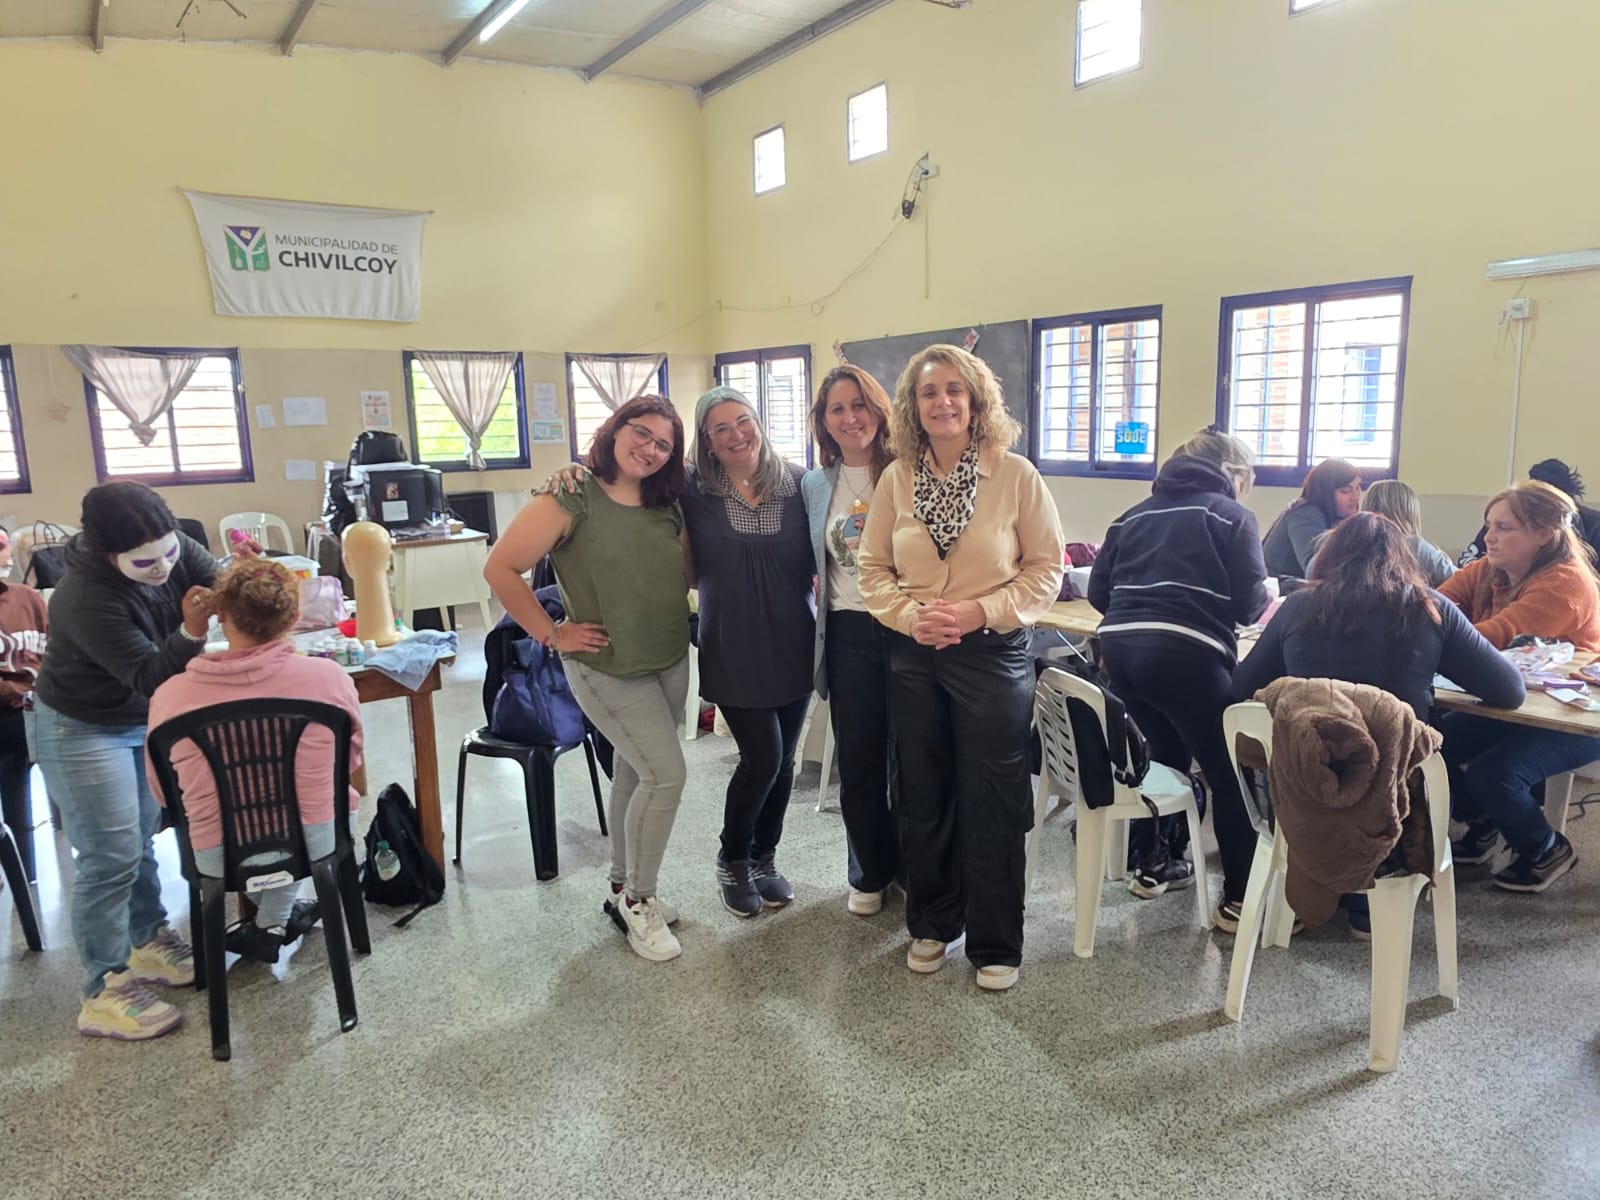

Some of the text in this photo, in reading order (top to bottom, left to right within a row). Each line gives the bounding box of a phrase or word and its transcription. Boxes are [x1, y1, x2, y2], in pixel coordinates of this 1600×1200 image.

[275, 234, 399, 255] MUNICIPALIDAD DE
[278, 250, 397, 275] CHIVILCOY
